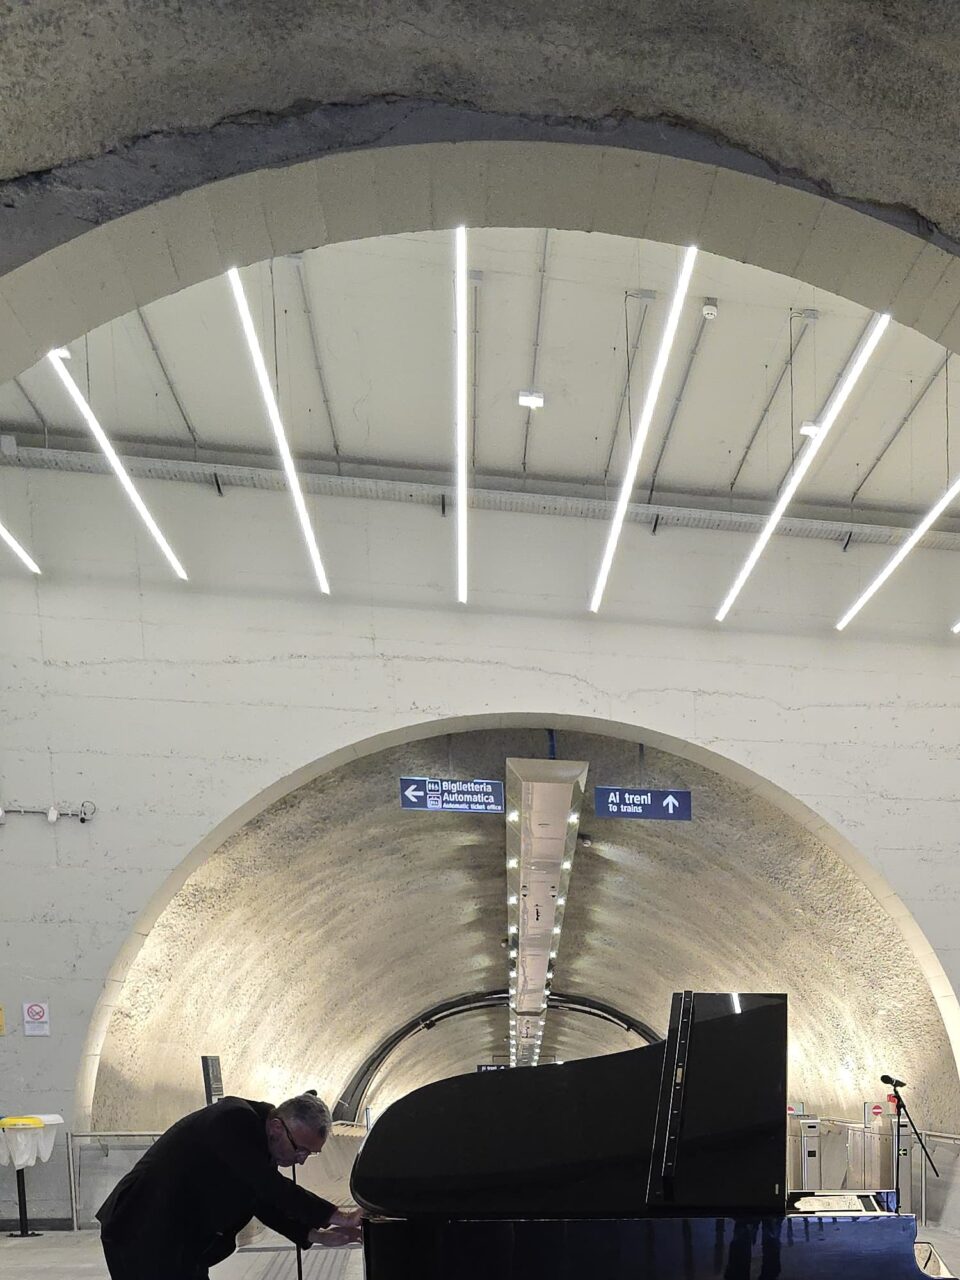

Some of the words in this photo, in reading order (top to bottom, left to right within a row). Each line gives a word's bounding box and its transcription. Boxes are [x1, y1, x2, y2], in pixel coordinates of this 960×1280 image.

[443, 781, 492, 792] Biglietteria
[443, 792, 494, 803] Automatica
[608, 792, 620, 803] Ai
[625, 793, 651, 804] treni
[608, 803, 617, 812] To
[620, 804, 642, 813] trains
